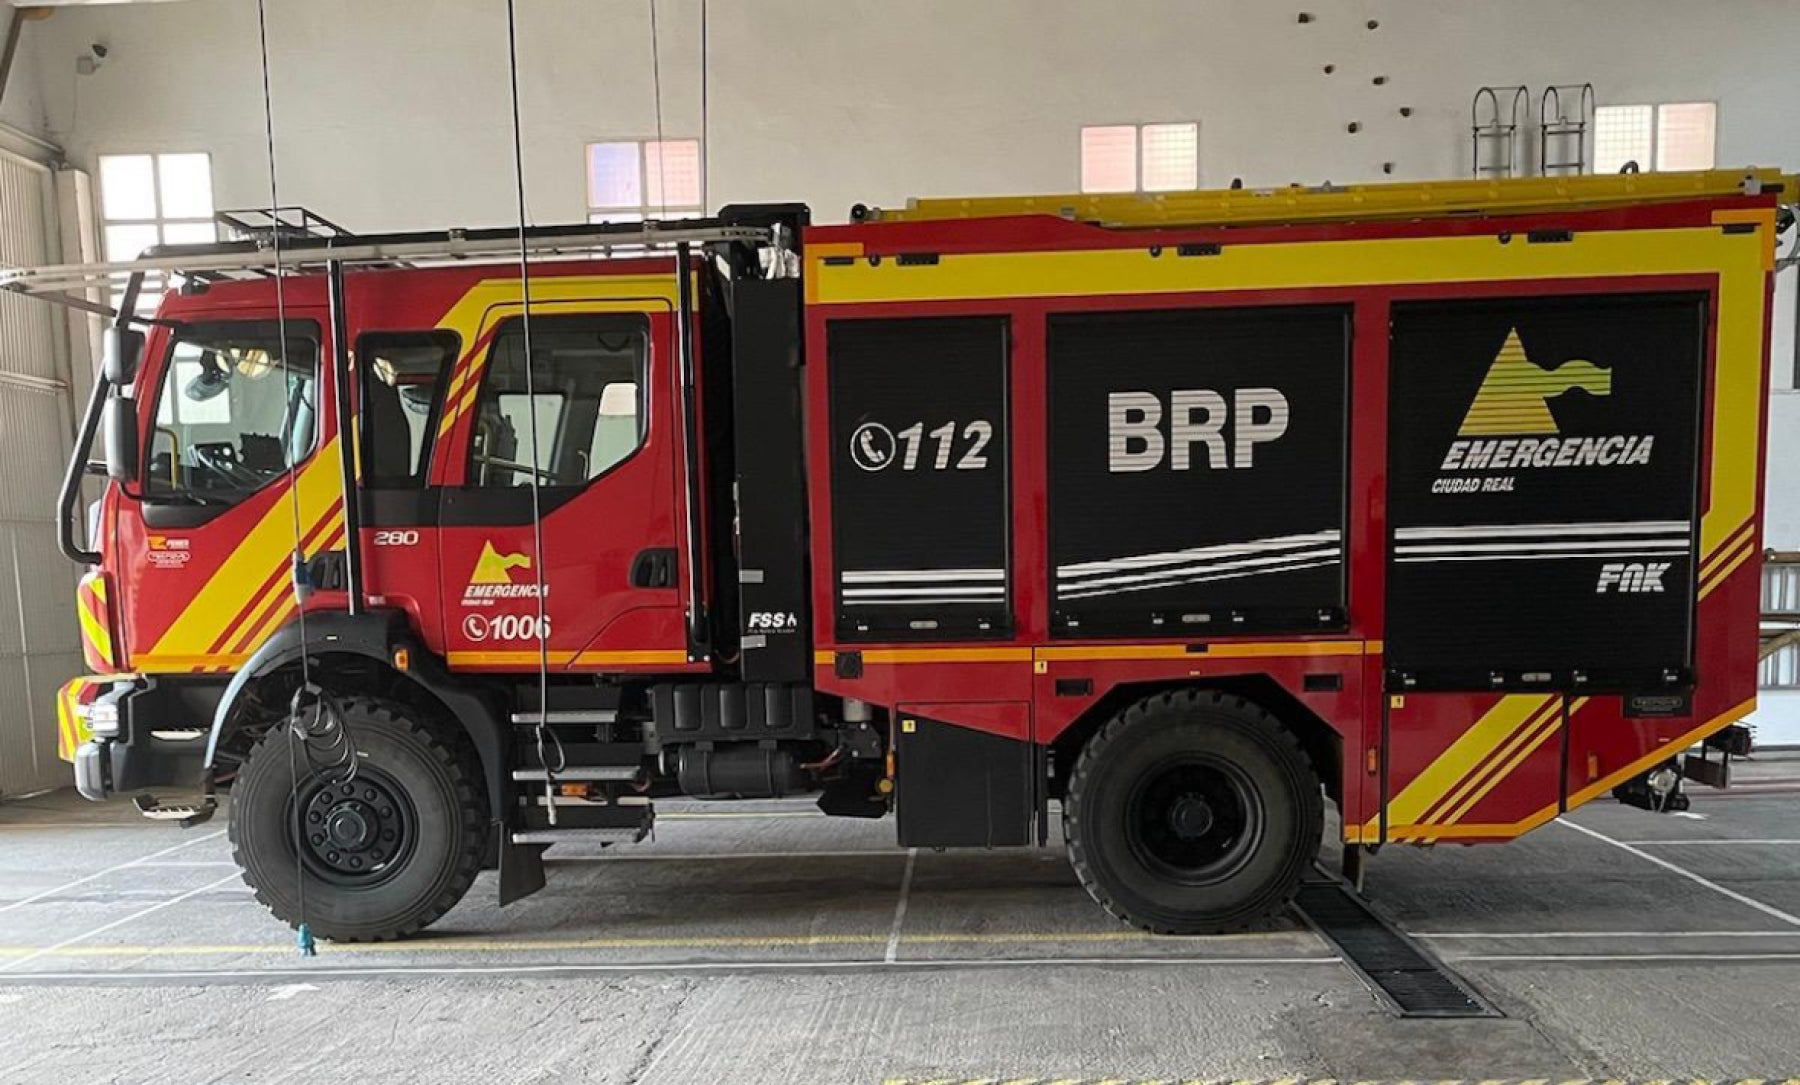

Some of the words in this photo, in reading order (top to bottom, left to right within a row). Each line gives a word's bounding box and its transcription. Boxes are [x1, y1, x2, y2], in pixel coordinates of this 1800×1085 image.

[1108, 388, 1290, 473] BRP
[898, 420, 992, 471] 112
[1441, 435, 1655, 470] EMERGENCIA
[1431, 478, 1480, 493] CIUDAD
[1481, 476, 1515, 492] REAL
[374, 530, 419, 546] 280
[489, 614, 551, 640] 1006
[748, 611, 786, 628] FSS
